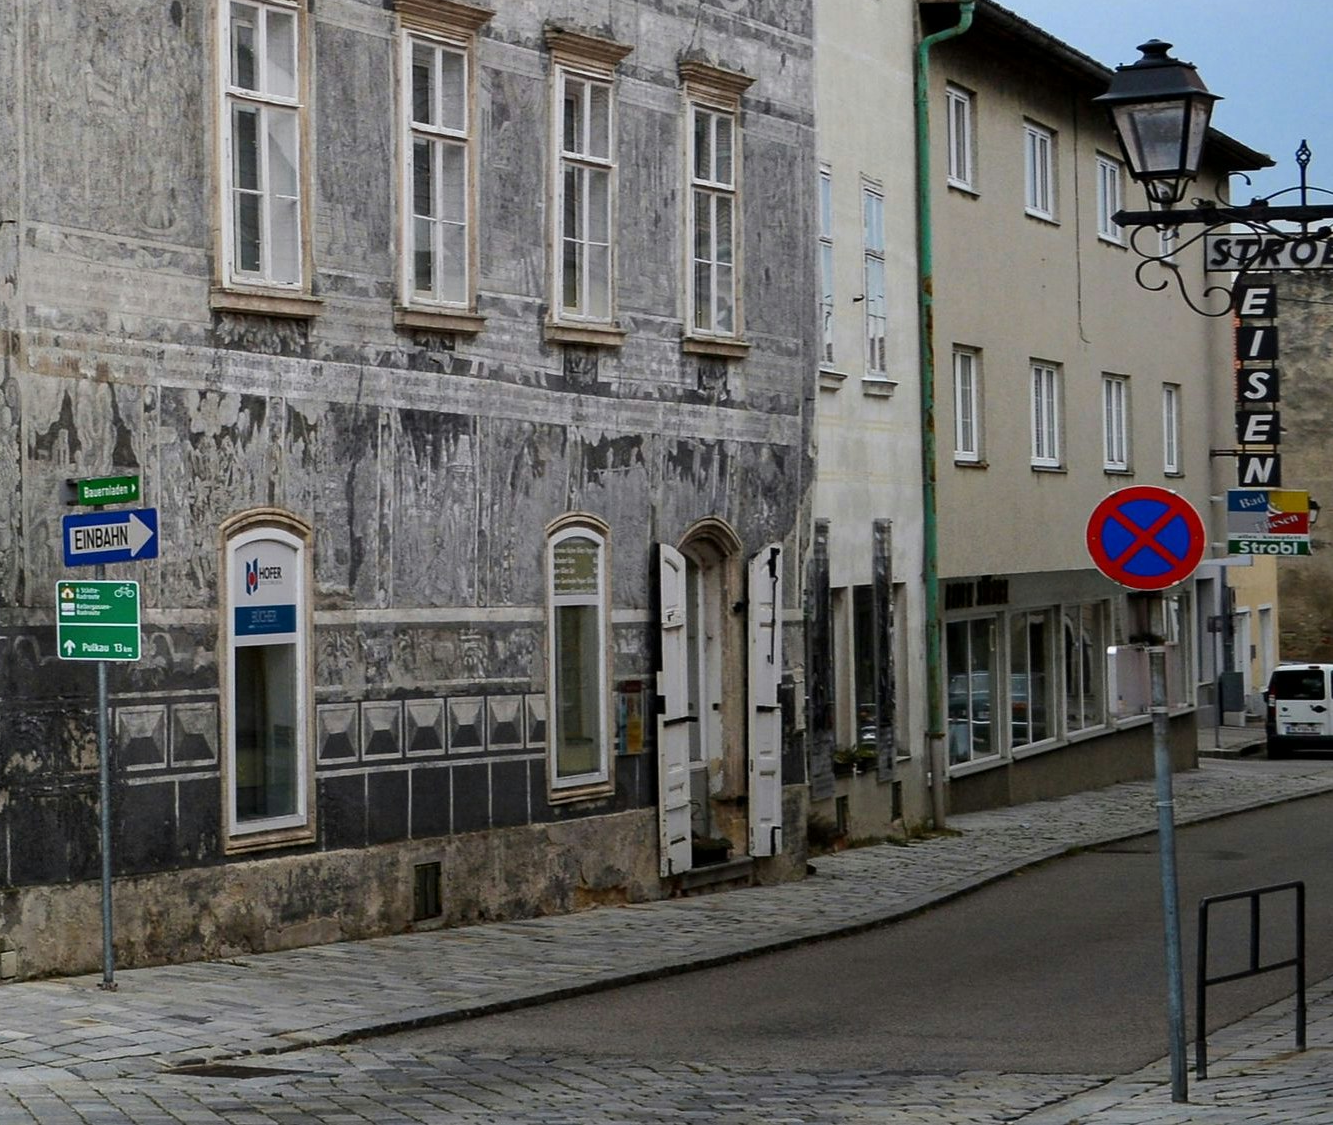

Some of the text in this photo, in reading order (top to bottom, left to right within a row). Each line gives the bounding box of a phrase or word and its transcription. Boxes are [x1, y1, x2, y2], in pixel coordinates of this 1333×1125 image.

[1240, 288, 1275, 484] EISEN
[84, 484, 128, 499] Bauernladen
[1239, 493, 1266, 509] Bad
[74, 525, 129, 551] EINBAHN
[1239, 541, 1298, 554] Strobl
[259, 566, 283, 580] HOFER
[114, 643, 123, 653] 13
